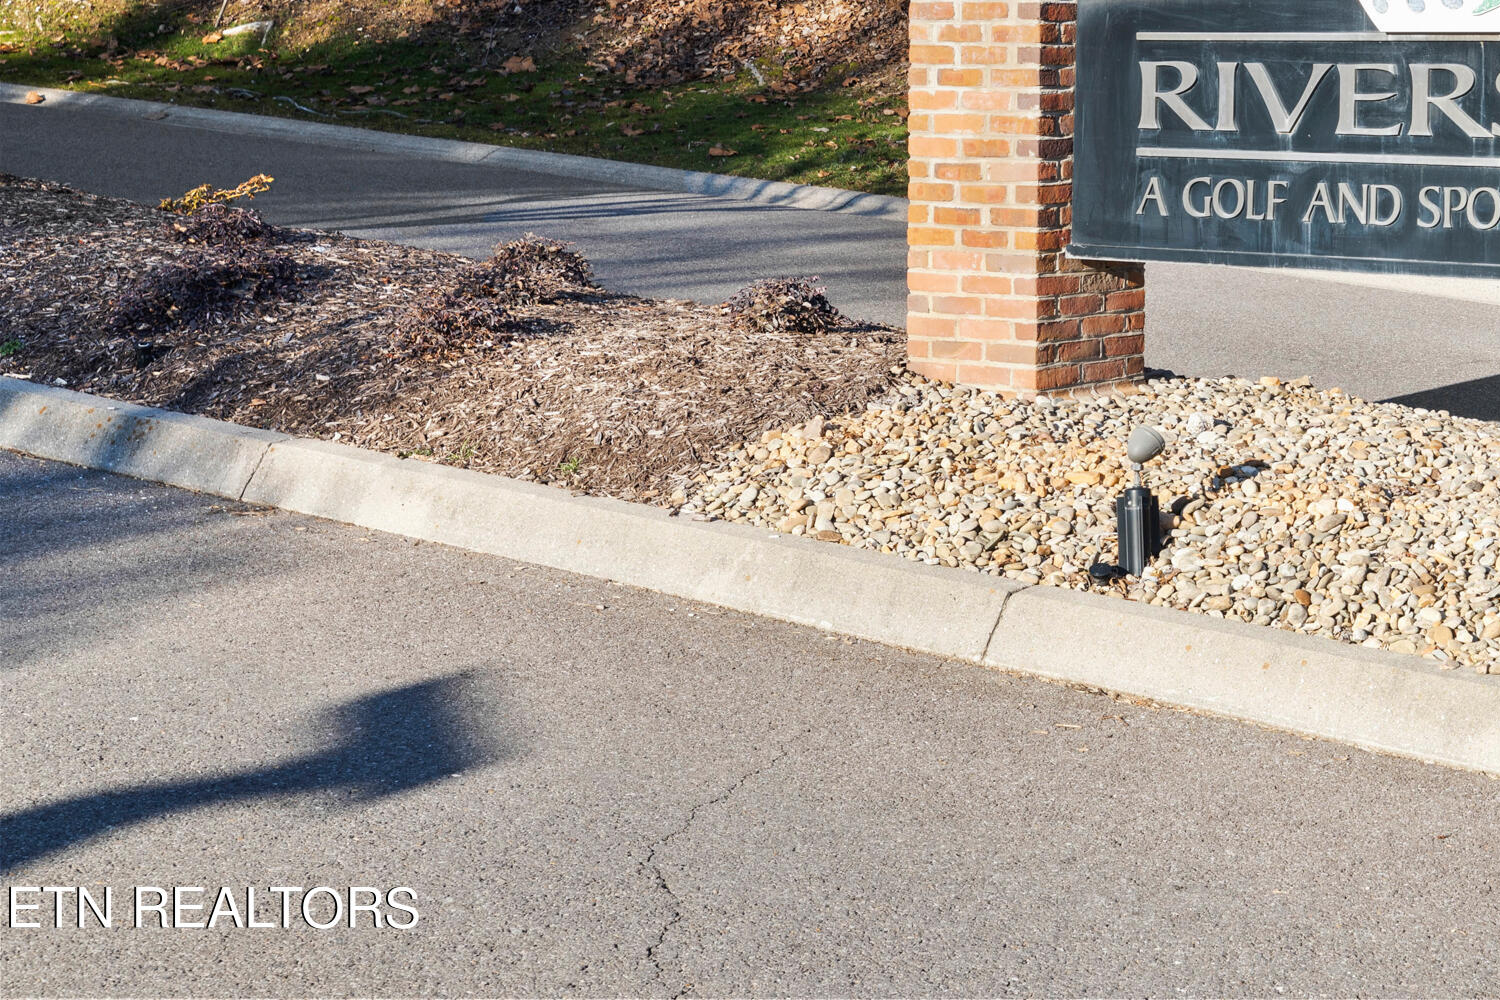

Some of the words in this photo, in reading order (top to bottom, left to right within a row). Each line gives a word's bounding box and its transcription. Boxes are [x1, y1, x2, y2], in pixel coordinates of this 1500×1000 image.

[1135, 175, 1169, 217] A
[1182, 175, 1288, 222] GOLF
[1302, 180, 1402, 228] AND
